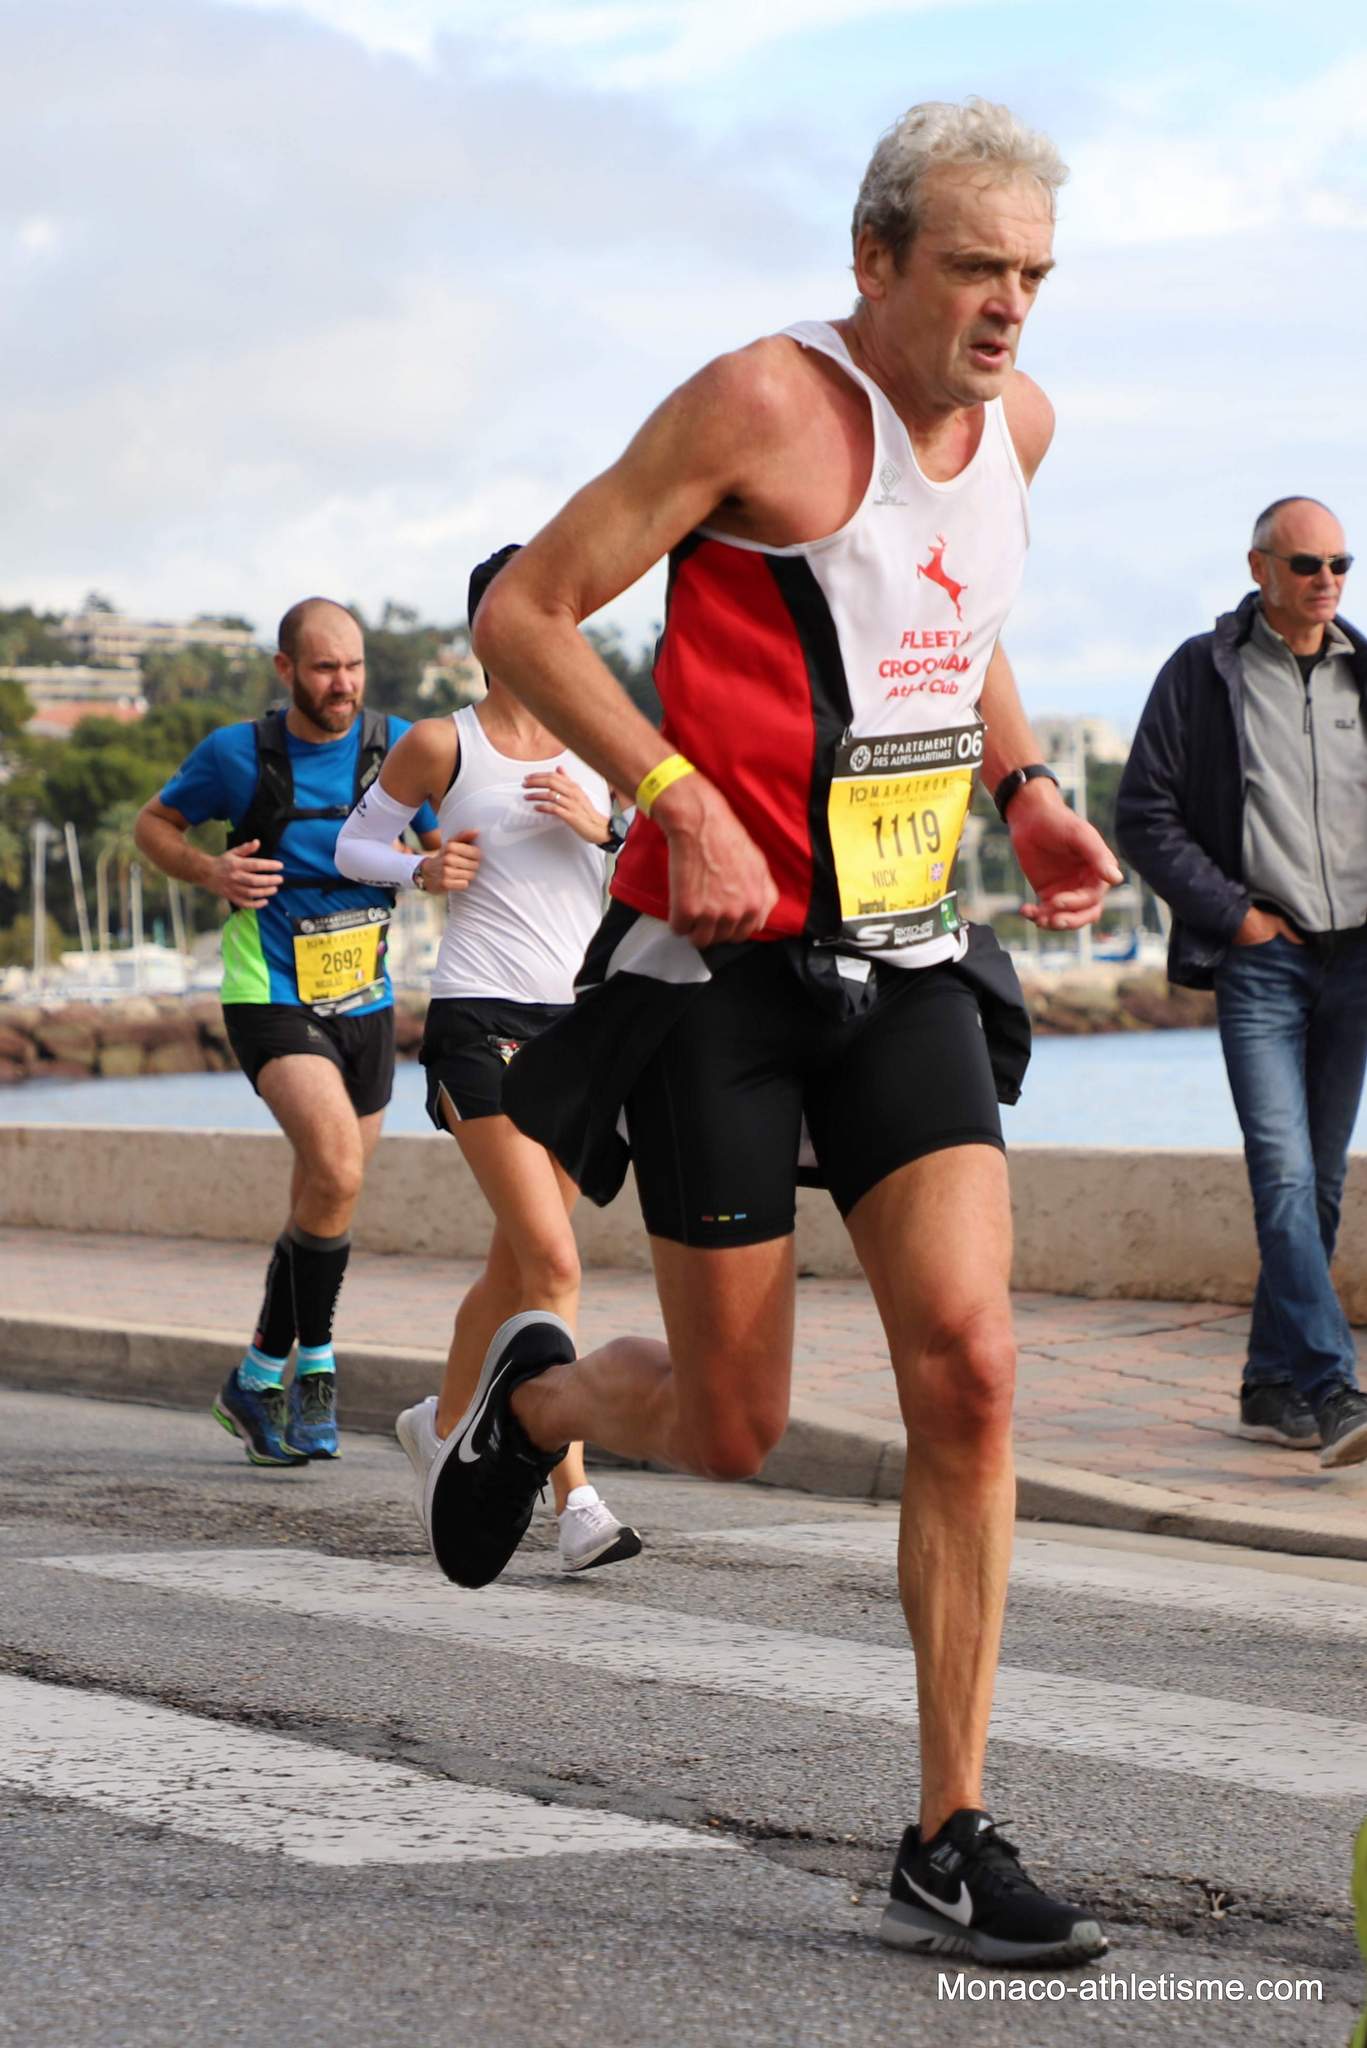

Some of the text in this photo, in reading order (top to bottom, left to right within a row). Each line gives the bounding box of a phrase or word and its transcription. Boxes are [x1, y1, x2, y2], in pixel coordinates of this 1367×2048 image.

[900, 631, 960, 648] FLEET
[874, 736, 953, 756] DÉPARTEMENT
[957, 730, 983, 759] 06
[872, 749, 952, 767] DES ALPES-MARITIMES
[872, 809, 942, 859] 1119
[872, 868, 899, 889] NICK
[321, 947, 363, 975] 2692
